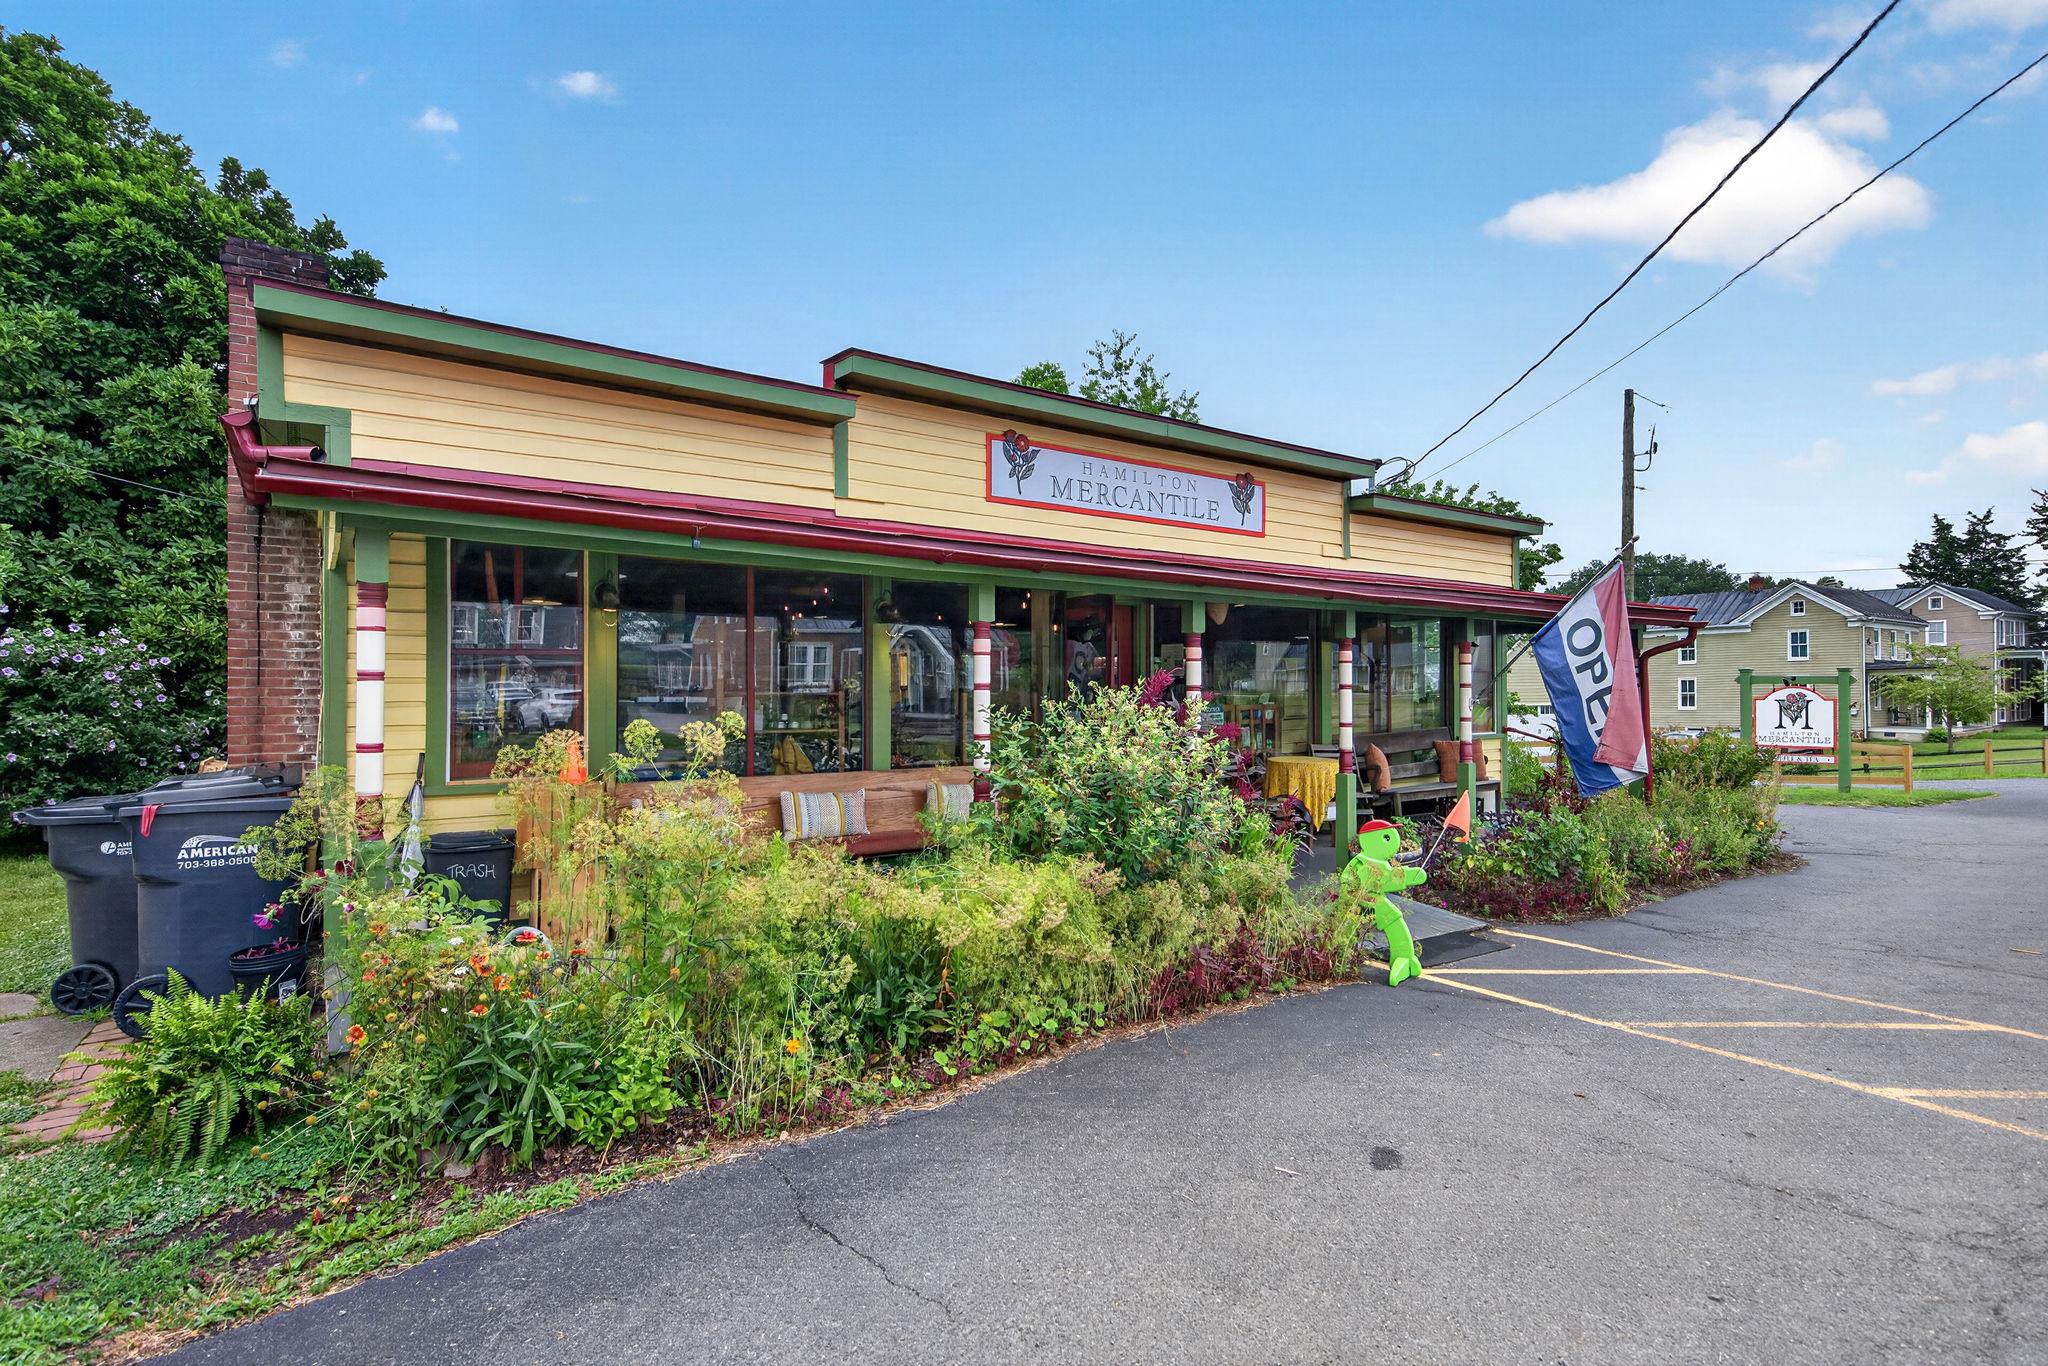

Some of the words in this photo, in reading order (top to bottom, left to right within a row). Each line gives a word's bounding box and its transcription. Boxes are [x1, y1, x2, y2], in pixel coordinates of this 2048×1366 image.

[1082, 461, 1197, 492] HAMILTON
[1050, 475, 1220, 521] MERCANTILE
[1758, 735, 1831, 744] MERCANTILE
[177, 844, 258, 859] AMERICAN
[446, 864, 496, 878] TRASH
